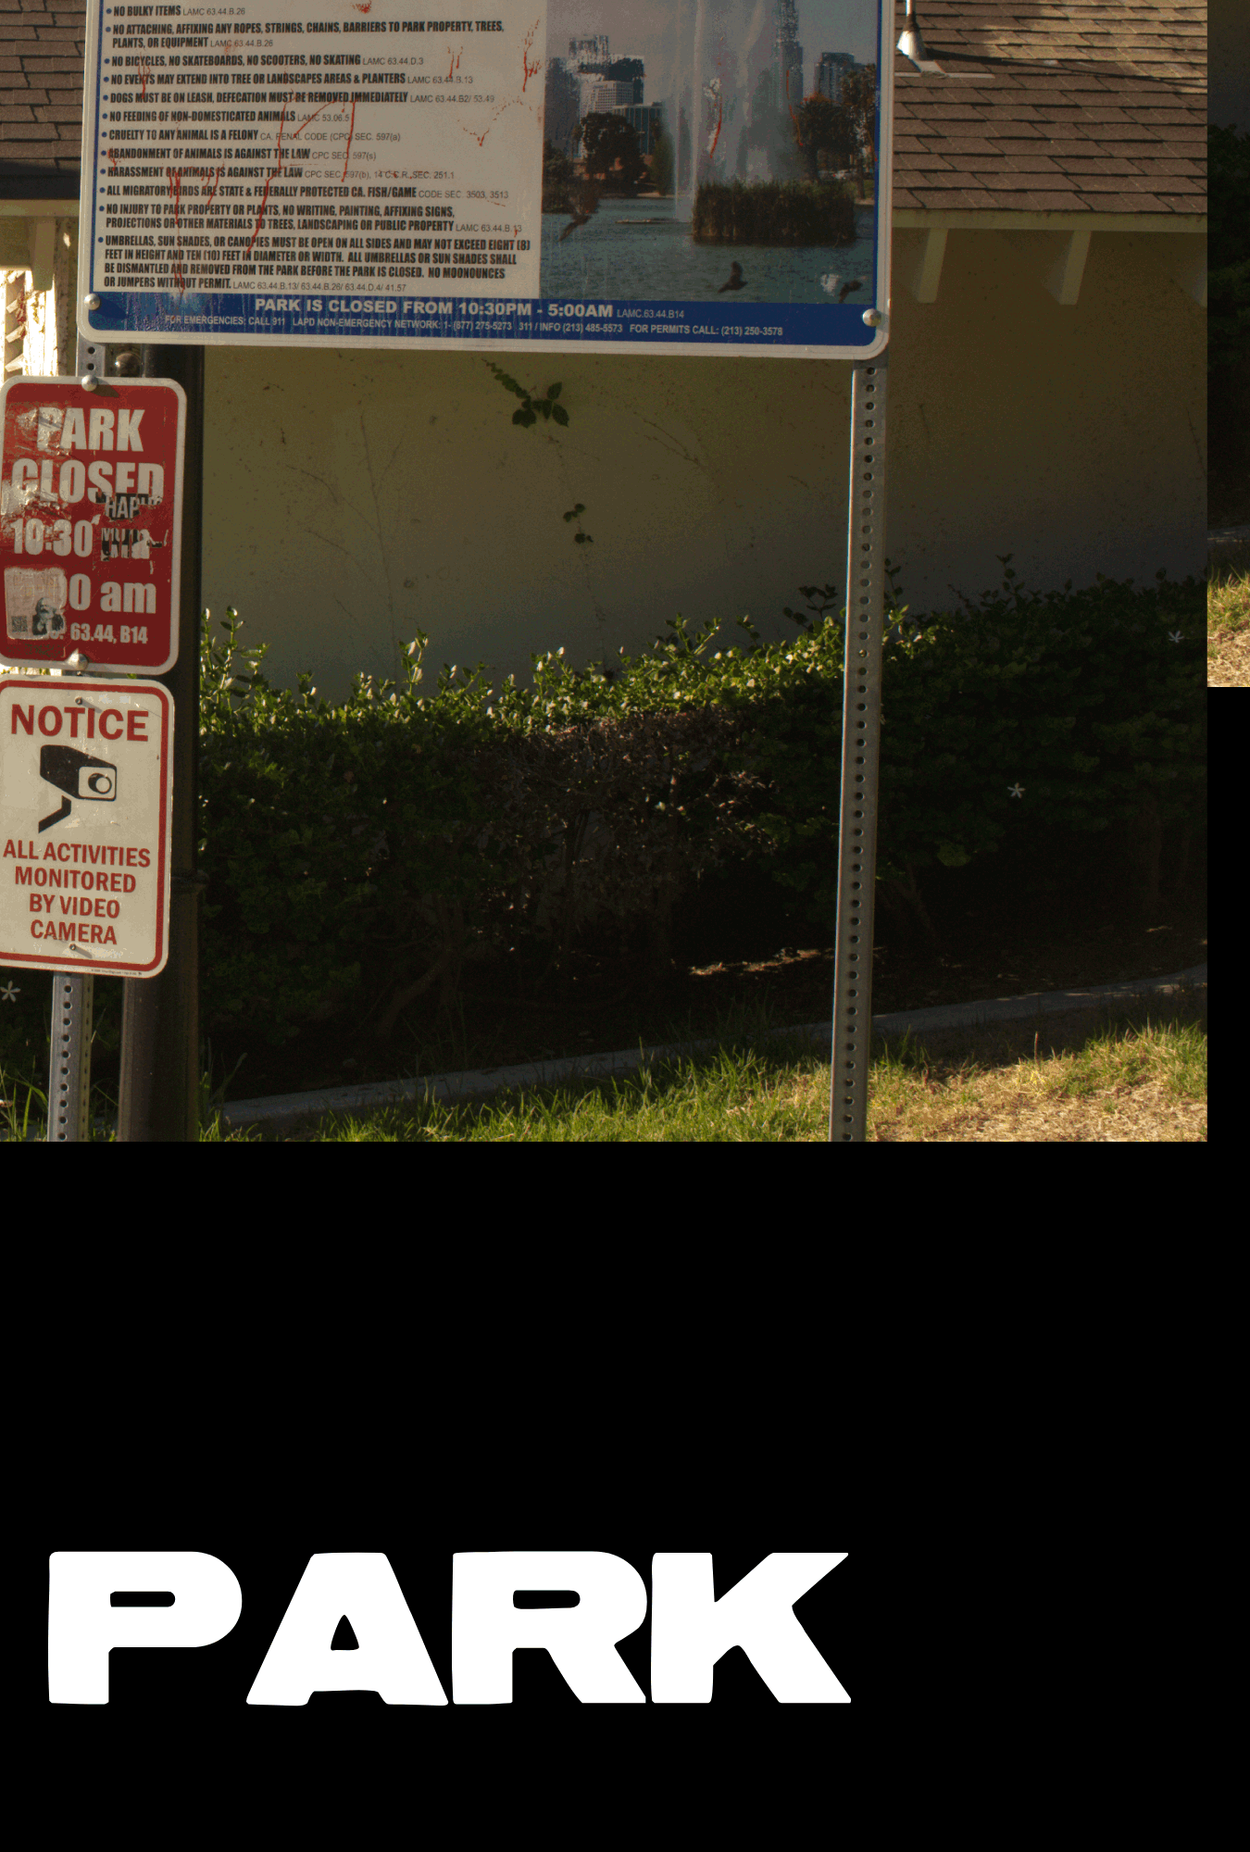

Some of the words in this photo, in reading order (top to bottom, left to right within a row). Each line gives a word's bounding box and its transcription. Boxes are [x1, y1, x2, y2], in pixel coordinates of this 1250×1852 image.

[113, 5, 125, 15] NO
[126, 5, 153, 15] BULKY
[155, 5, 181, 15] ITEMS
[112, 23, 125, 34] NO
[125, 23, 174, 35] ATTACHING,
[176, 22, 214, 33] AFFIXING
[214, 22, 232, 33] ANY
[233, 22, 264, 34] ROPES,
[264, 21, 306, 34] STRINGS,
[306, 21, 343, 33] CHAINS,
[342, 21, 387, 32] BARRIERS
[388, 21, 400, 32] TO
[401, 20, 425, 32] PARK
[426, 20, 475, 32] PROPERTY,
[475, 20, 505, 32] TREES,
[111, 37, 146, 48] PLANTS,
[146, 37, 159, 47] OR
[160, 36, 208, 47] EQUIPMENT
[103, 263, 114, 274] BE
[116, 263, 169, 274] DISMANTLED
[190, 263, 230, 275] REMOVED
[232, 264, 256, 275] FROM
[258, 264, 274, 275] THE
[275, 264, 298, 276] PARK
[300, 265, 332, 276] BEFORE
[334, 265, 350, 276] THE
[352, 265, 375, 276] PARK
[377, 265, 386, 276] IS
[428, 266, 441, 277] NO
[254, 299, 301, 312] PARK
[305, 299, 323, 312] IS
[328, 300, 397, 313] CLOSED
[402, 301, 453, 314] FROM
[458, 300, 532, 317] 10:30PM
[547, 303, 612, 317] 5:00AM
[165, 315, 182, 324] FOR
[248, 316, 270, 326] CALL
[272, 316, 285, 326] 911
[292, 317, 314, 327] LAPD
[317, 318, 391, 328] NON-EMERGENCY
[453, 320, 473, 331] (877)
[475, 320, 512, 330] 275-5273
[518, 321, 532, 331] 311
[539, 322, 560, 332] INFO
[562, 322, 583, 333] (213)
[584, 323, 622, 333] 485-5573
[629, 324, 647, 333] FOR
[650, 324, 689, 334] PERMITS
[720, 325, 742, 336] (213)
[744, 326, 783, 336] 250-3578
[37, 406, 146, 452] PARK
[11, 458, 165, 504] CLOSED
[10, 518, 93, 558] 10:30
[70, 622, 118, 645] 63.44,
[120, 625, 149, 644] B14
[11, 704, 149, 742] NOTICE
[3, 839, 39, 860] ALL
[43, 842, 151, 868] ACTIVITIES
[15, 866, 137, 893] MONITORED
[29, 893, 56, 913] BY
[59, 895, 120, 918] VIDEO
[30, 919, 118, 945] CAMERA
